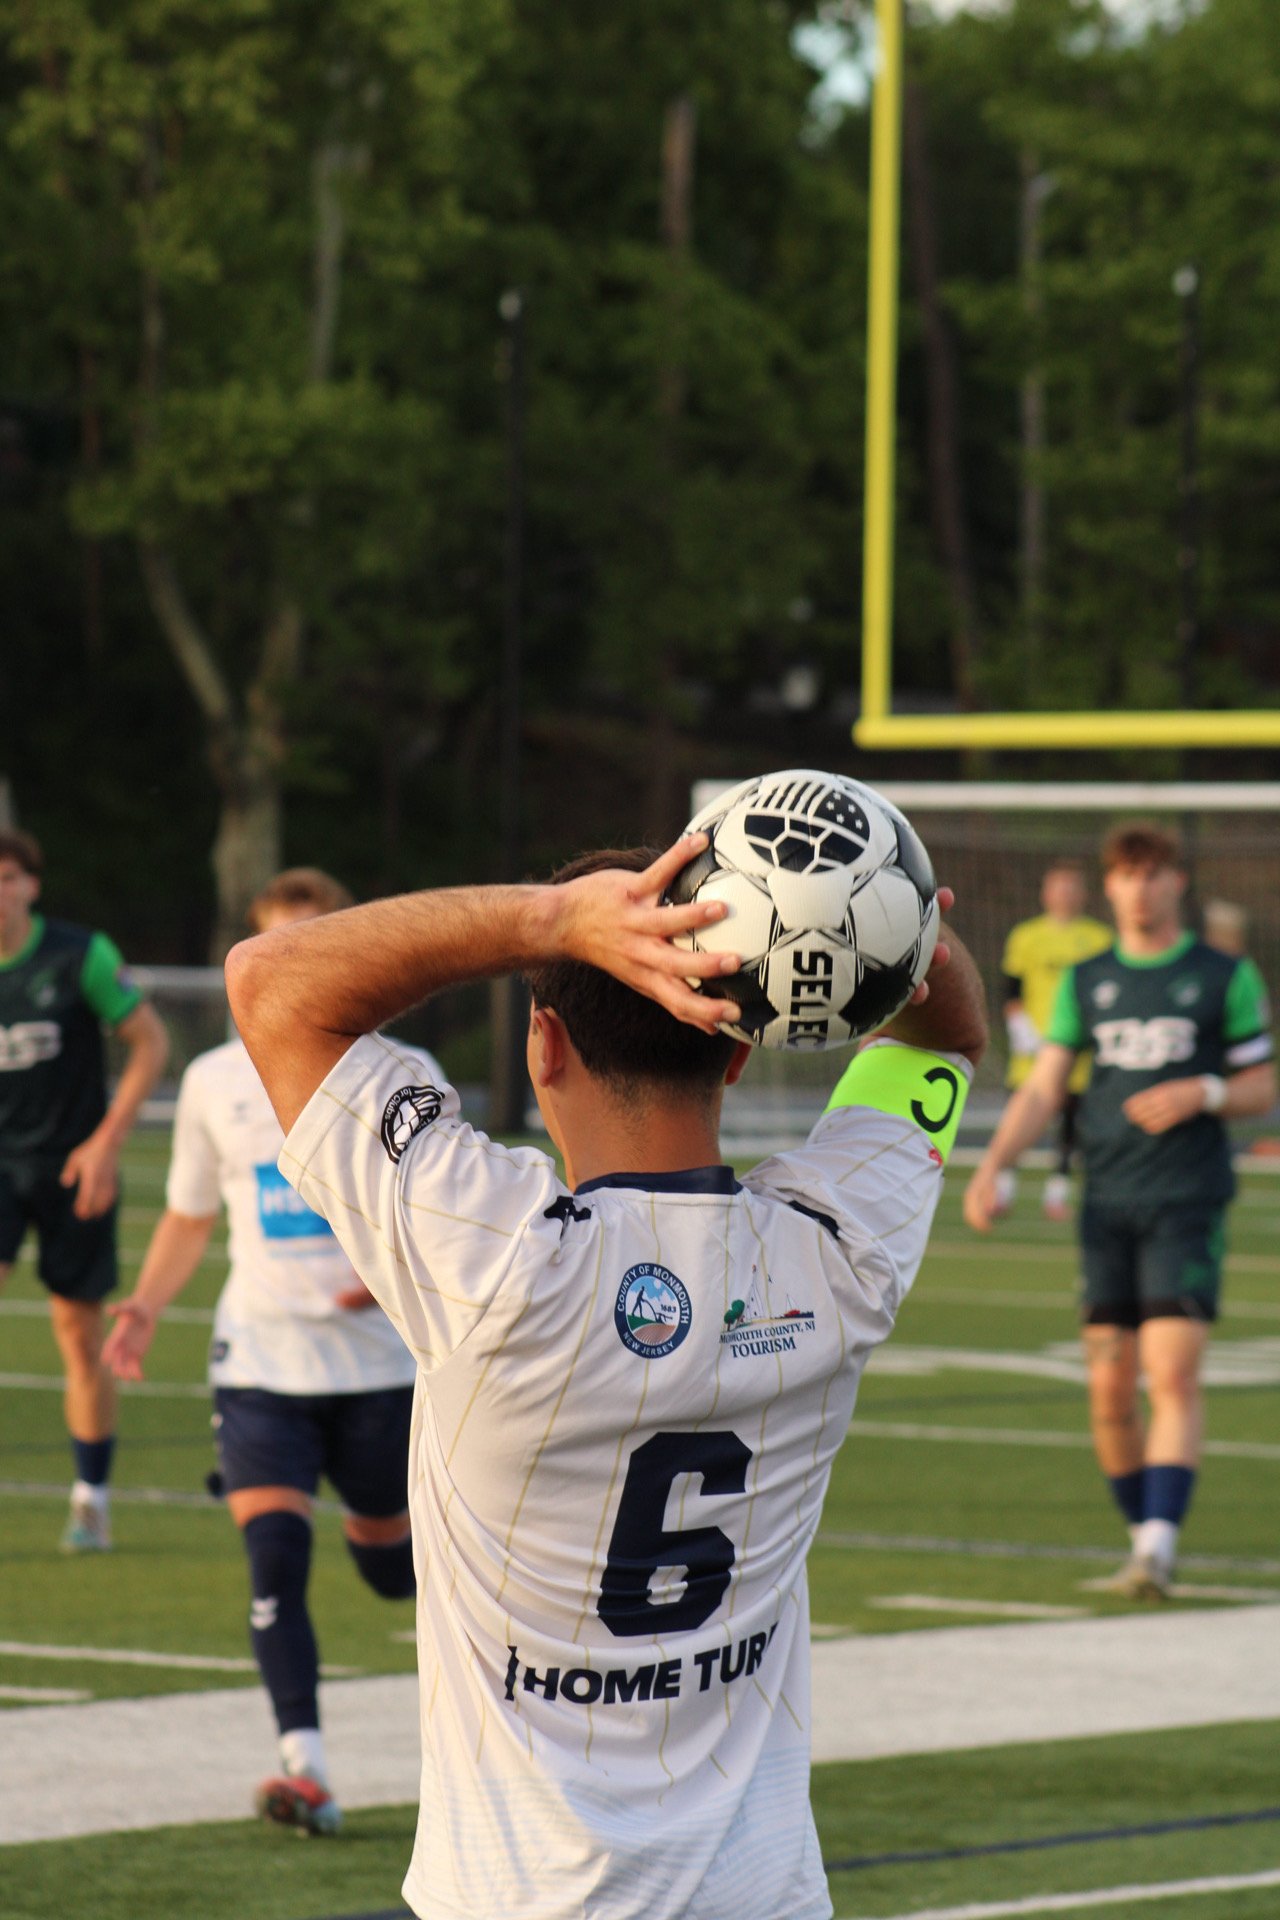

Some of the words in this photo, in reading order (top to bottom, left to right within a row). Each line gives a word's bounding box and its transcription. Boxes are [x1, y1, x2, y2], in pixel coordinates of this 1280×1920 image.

[385, 1096, 401, 1119] Clubs
[911, 1067, 958, 1133] C
[617, 1269, 638, 1312] COUNTY
[639, 1265, 650, 1275] OF
[653, 1266, 689, 1324] MONMOUTH
[623, 1331, 640, 1350] NEW
[641, 1341, 674, 1355] JERSEY
[764, 1322, 804, 1338] COUNTY,
[805, 1320, 816, 1331] NJ
[730, 1336, 797, 1358] TOURISM
[596, 1431, 753, 1637] 6
[523, 1658, 682, 1704] HOME
